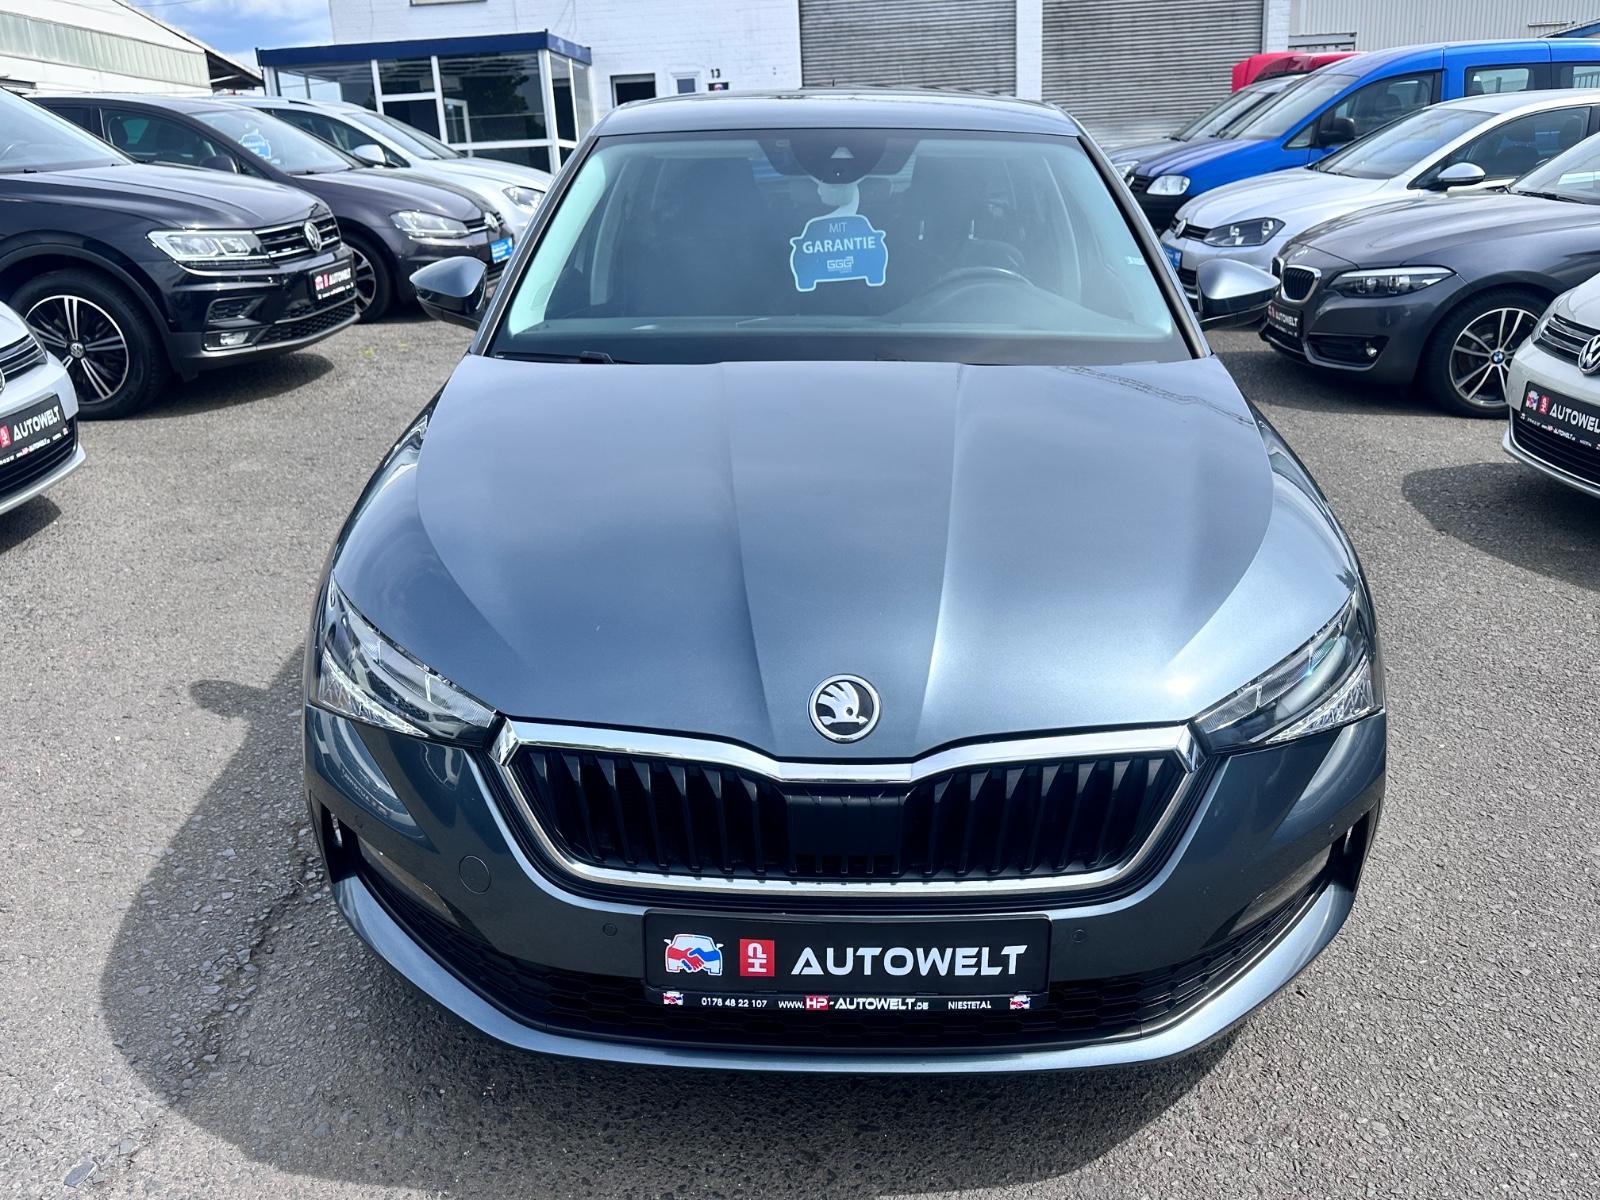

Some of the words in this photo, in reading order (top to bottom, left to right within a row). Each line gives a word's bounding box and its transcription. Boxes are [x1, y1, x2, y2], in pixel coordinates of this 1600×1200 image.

[710, 68, 721, 79] 13
[829, 222, 847, 233] MIT
[802, 236, 876, 254] GARANTIE
[13, 405, 60, 442] AUTOWELT
[791, 945, 1028, 976] AUTOWELT
[701, 997, 723, 1007] 0178
[724, 998, 736, 1007] 48
[737, 999, 749, 1008] 22
[751, 999, 768, 1008] 107
[948, 1000, 992, 1010] NIESTETAL
